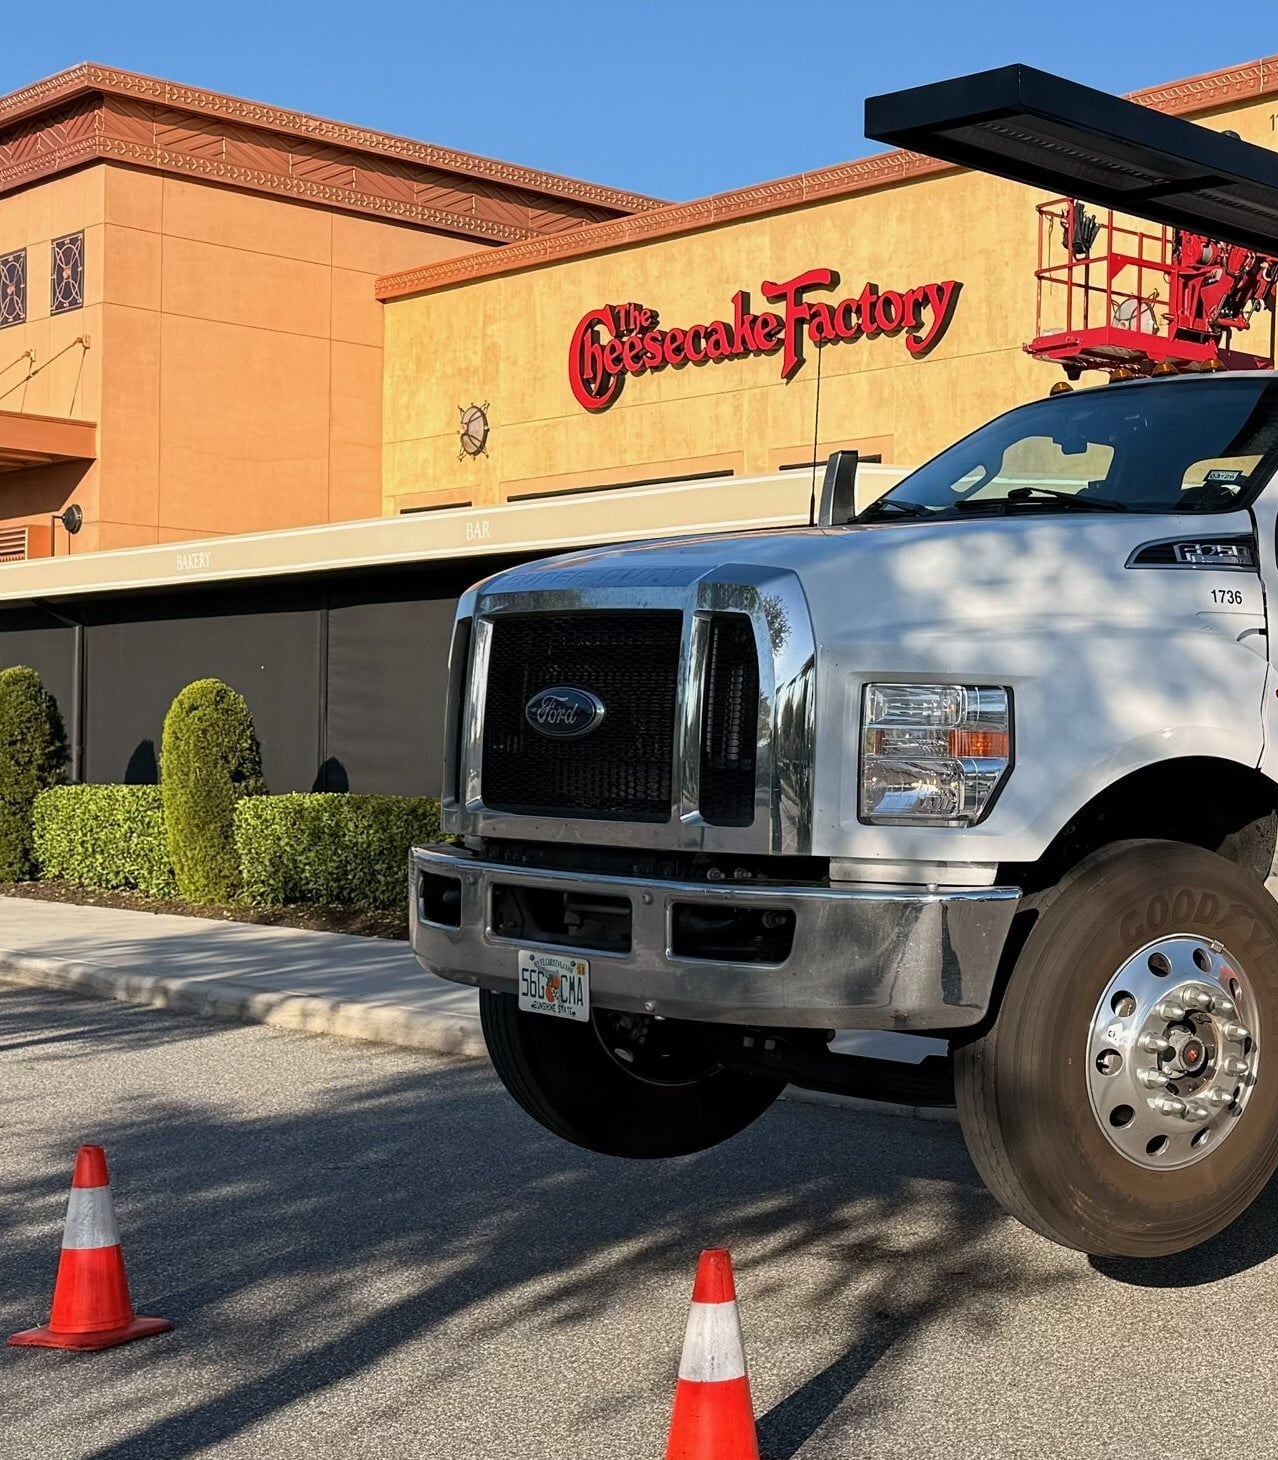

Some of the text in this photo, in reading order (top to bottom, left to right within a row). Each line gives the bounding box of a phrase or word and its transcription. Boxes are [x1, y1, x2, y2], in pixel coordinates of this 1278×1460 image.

[616, 303, 656, 336] The
[568, 268, 962, 411] Cheesecake Factory
[465, 521, 491, 540] BAR
[176, 552, 211, 571] BAKERY
[1210, 589, 1243, 605] 1736
[537, 695, 578, 724] Ford
